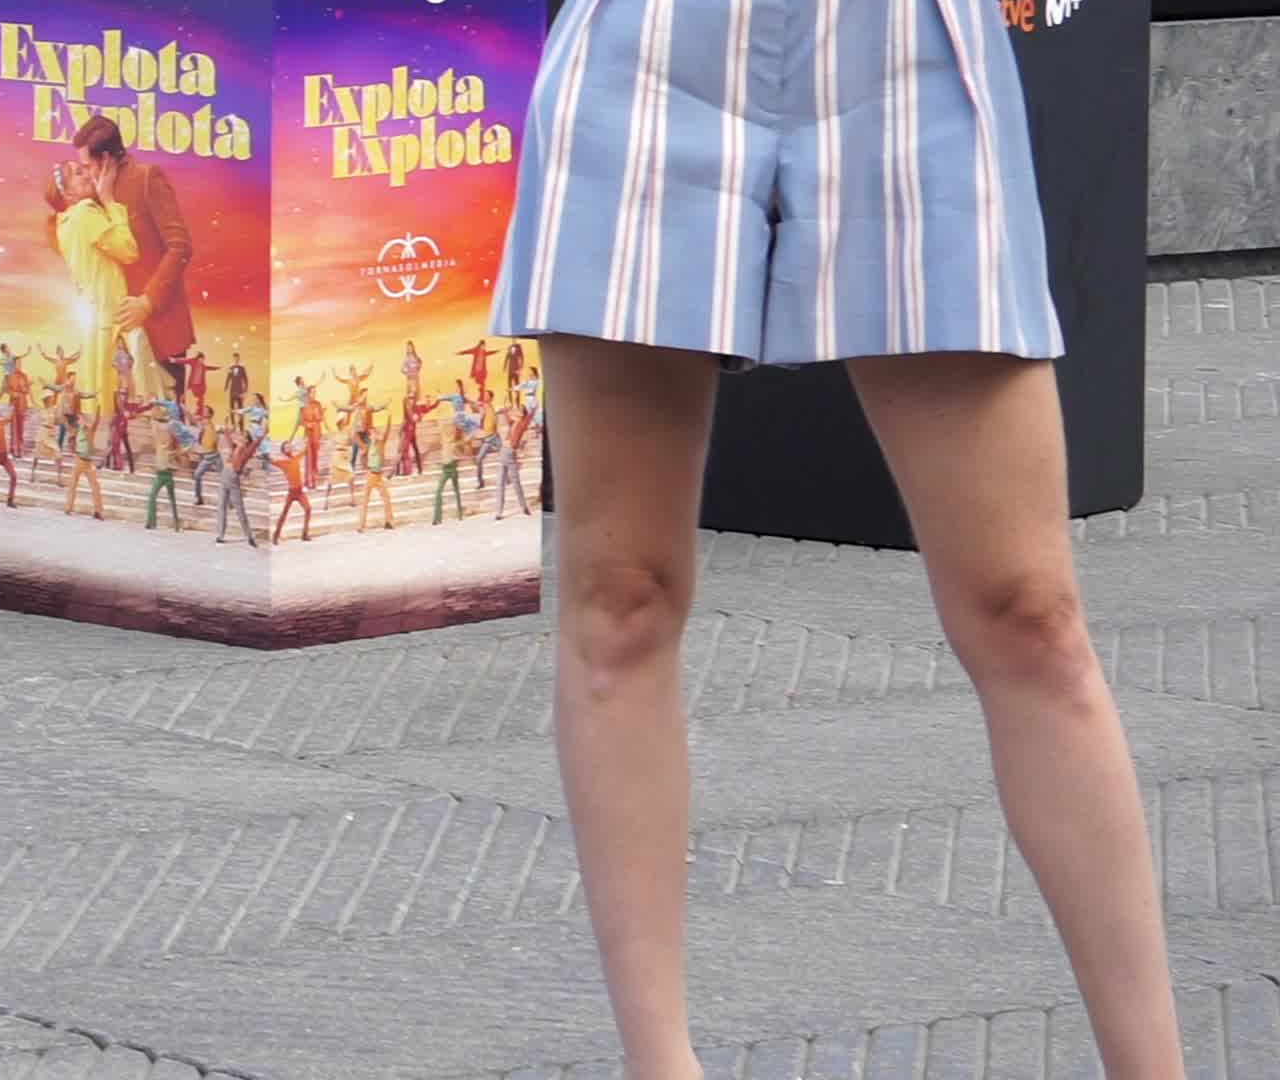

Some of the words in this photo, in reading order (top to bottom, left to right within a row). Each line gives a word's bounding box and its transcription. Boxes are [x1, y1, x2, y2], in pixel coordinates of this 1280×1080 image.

[0, 22, 216, 101] Explota
[303, 65, 485, 137] Explota
[331, 116, 513, 187] Explota
